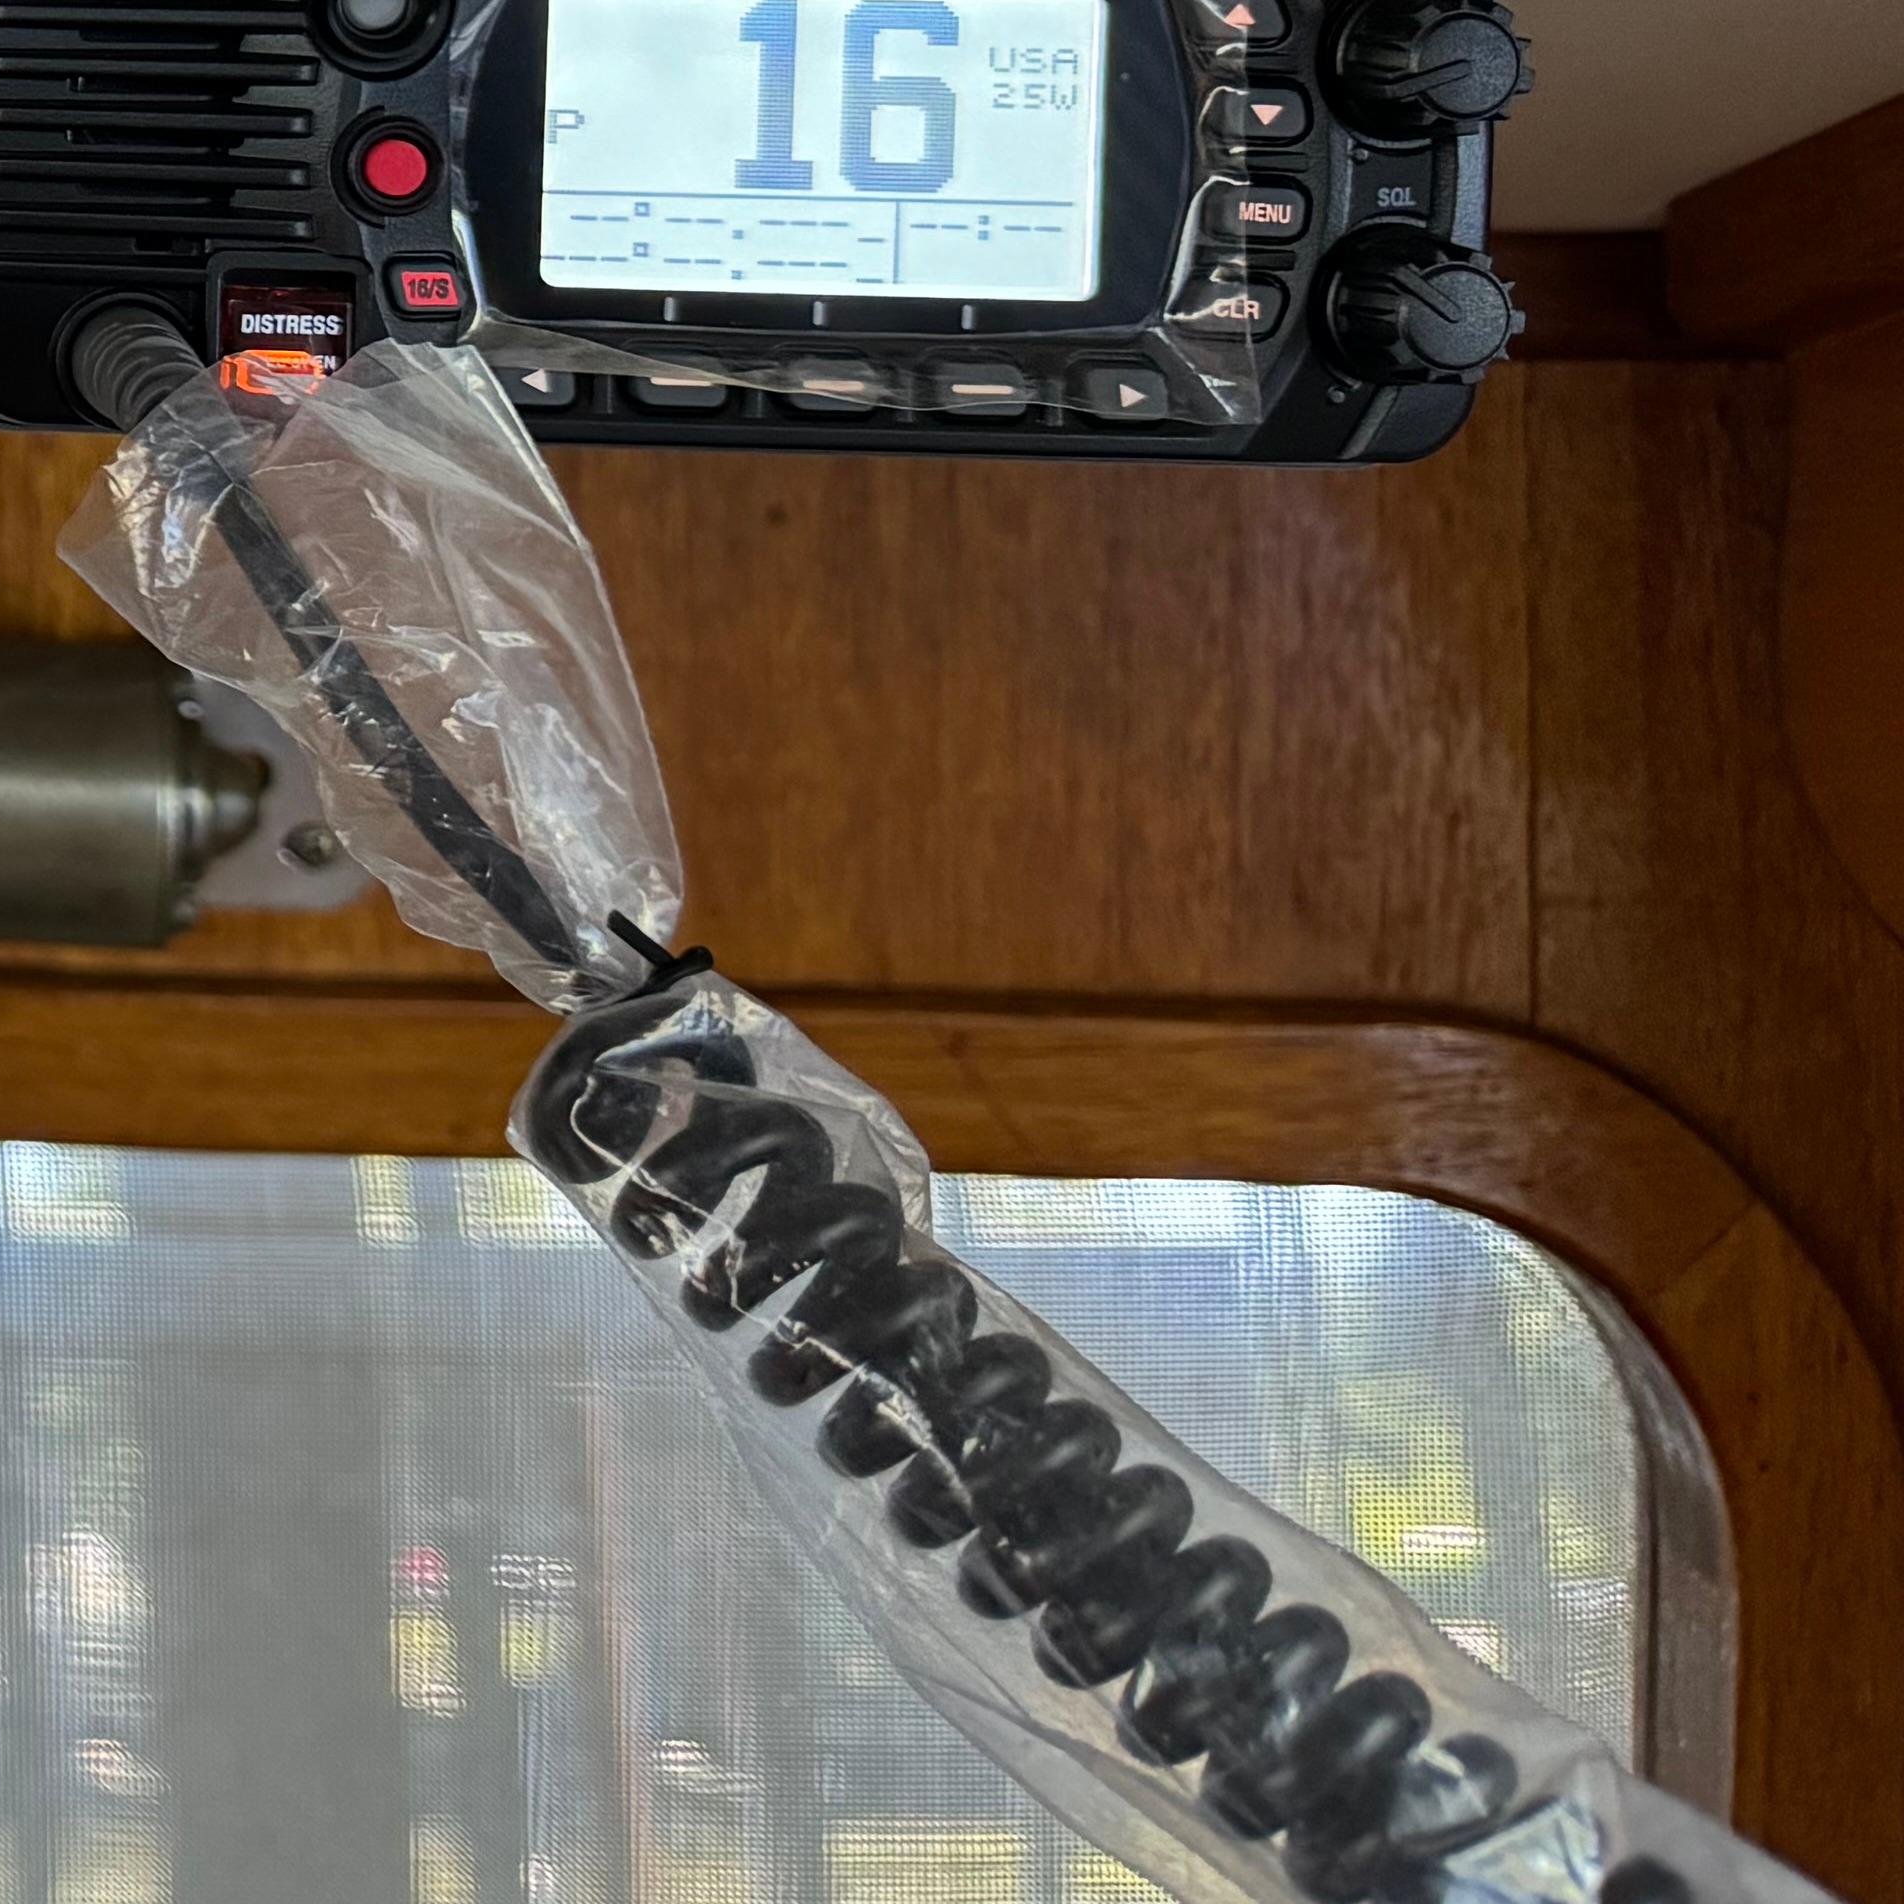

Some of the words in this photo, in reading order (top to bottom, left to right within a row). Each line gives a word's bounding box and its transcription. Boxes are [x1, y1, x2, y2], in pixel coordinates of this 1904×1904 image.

[988, 46, 1081, 76] USA
[991, 82, 1080, 111] 25W
[1238, 201, 1292, 225] MENU
[406, 278, 451, 299] 16/S
[1212, 298, 1260, 320] CLR
[240, 313, 344, 336] DISTRESS
